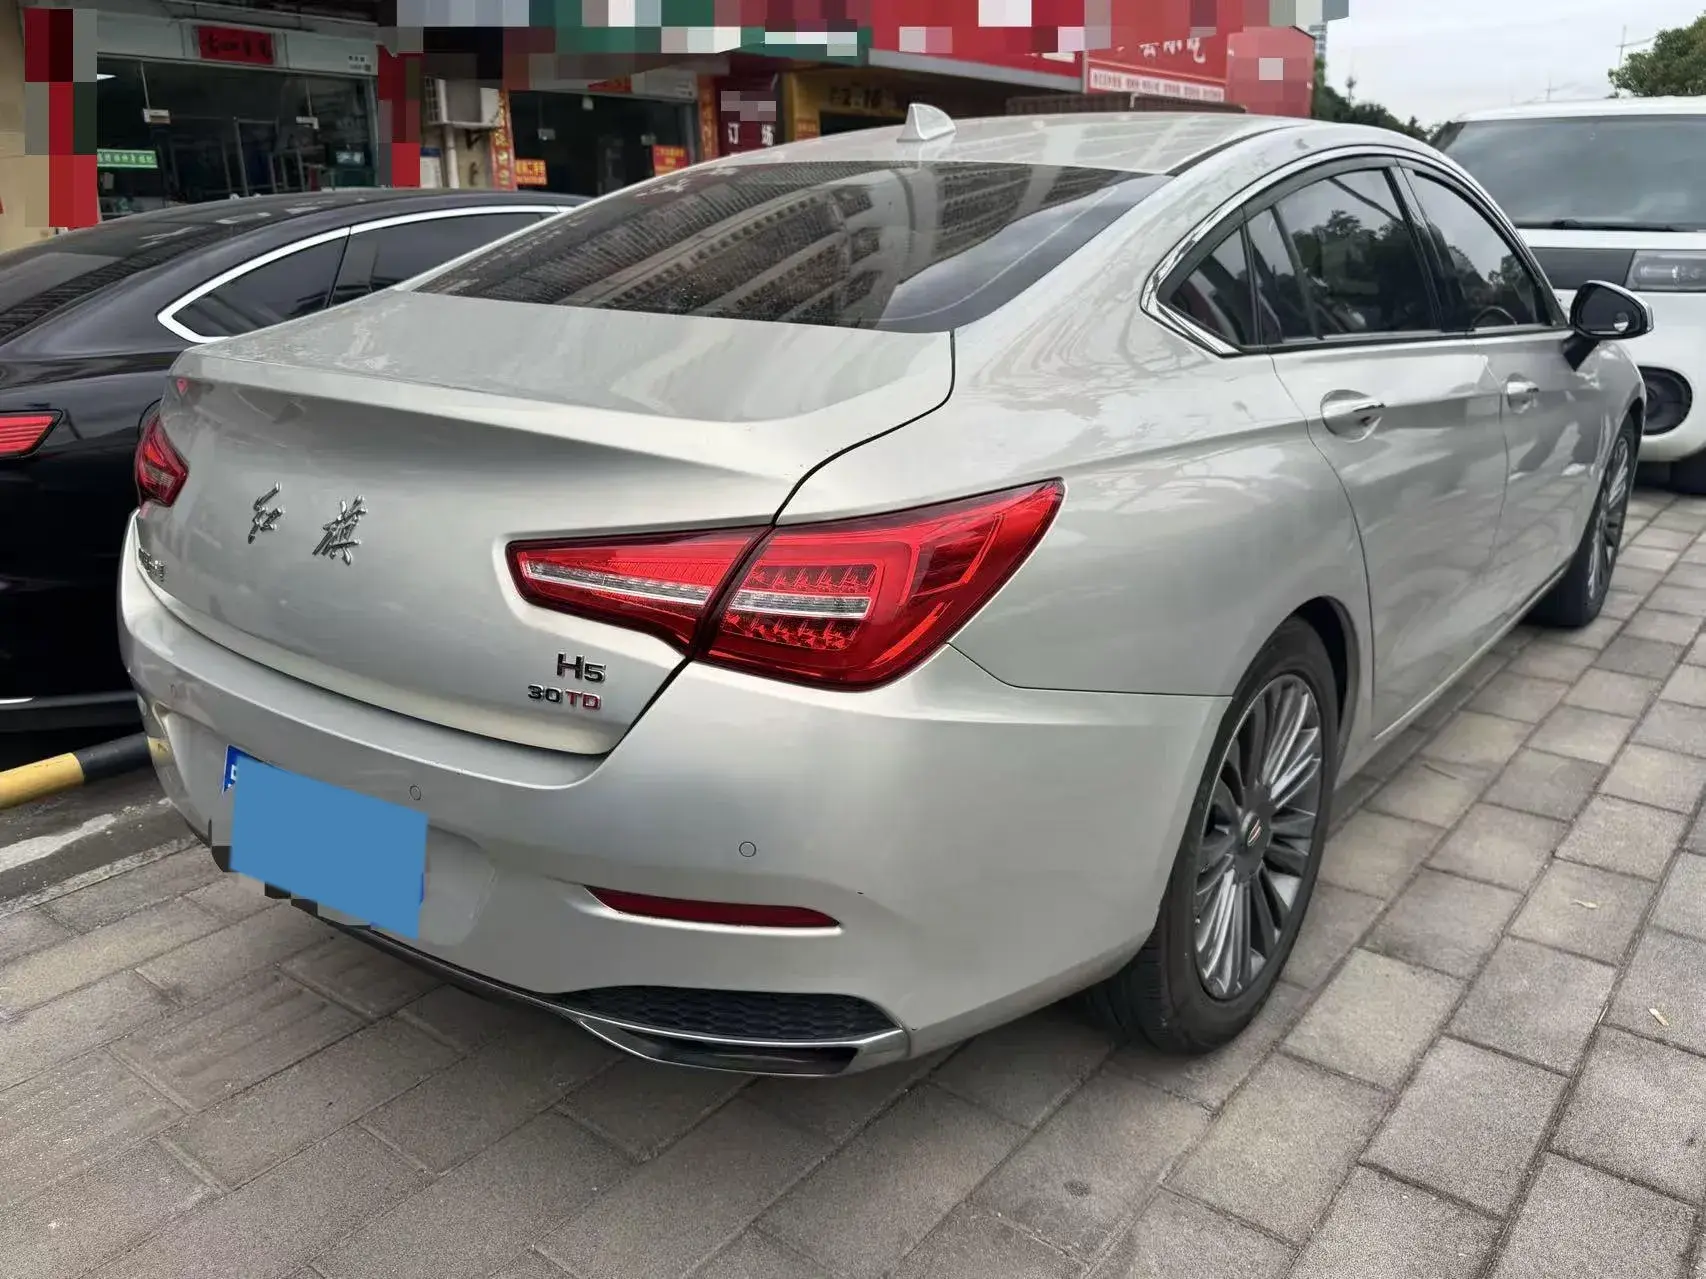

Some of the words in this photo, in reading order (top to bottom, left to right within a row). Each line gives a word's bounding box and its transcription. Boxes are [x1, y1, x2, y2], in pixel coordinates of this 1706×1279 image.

[248, 481, 367, 565] 红旗
[556, 653, 607, 683] H5
[527, 684, 602, 711] 30TD
